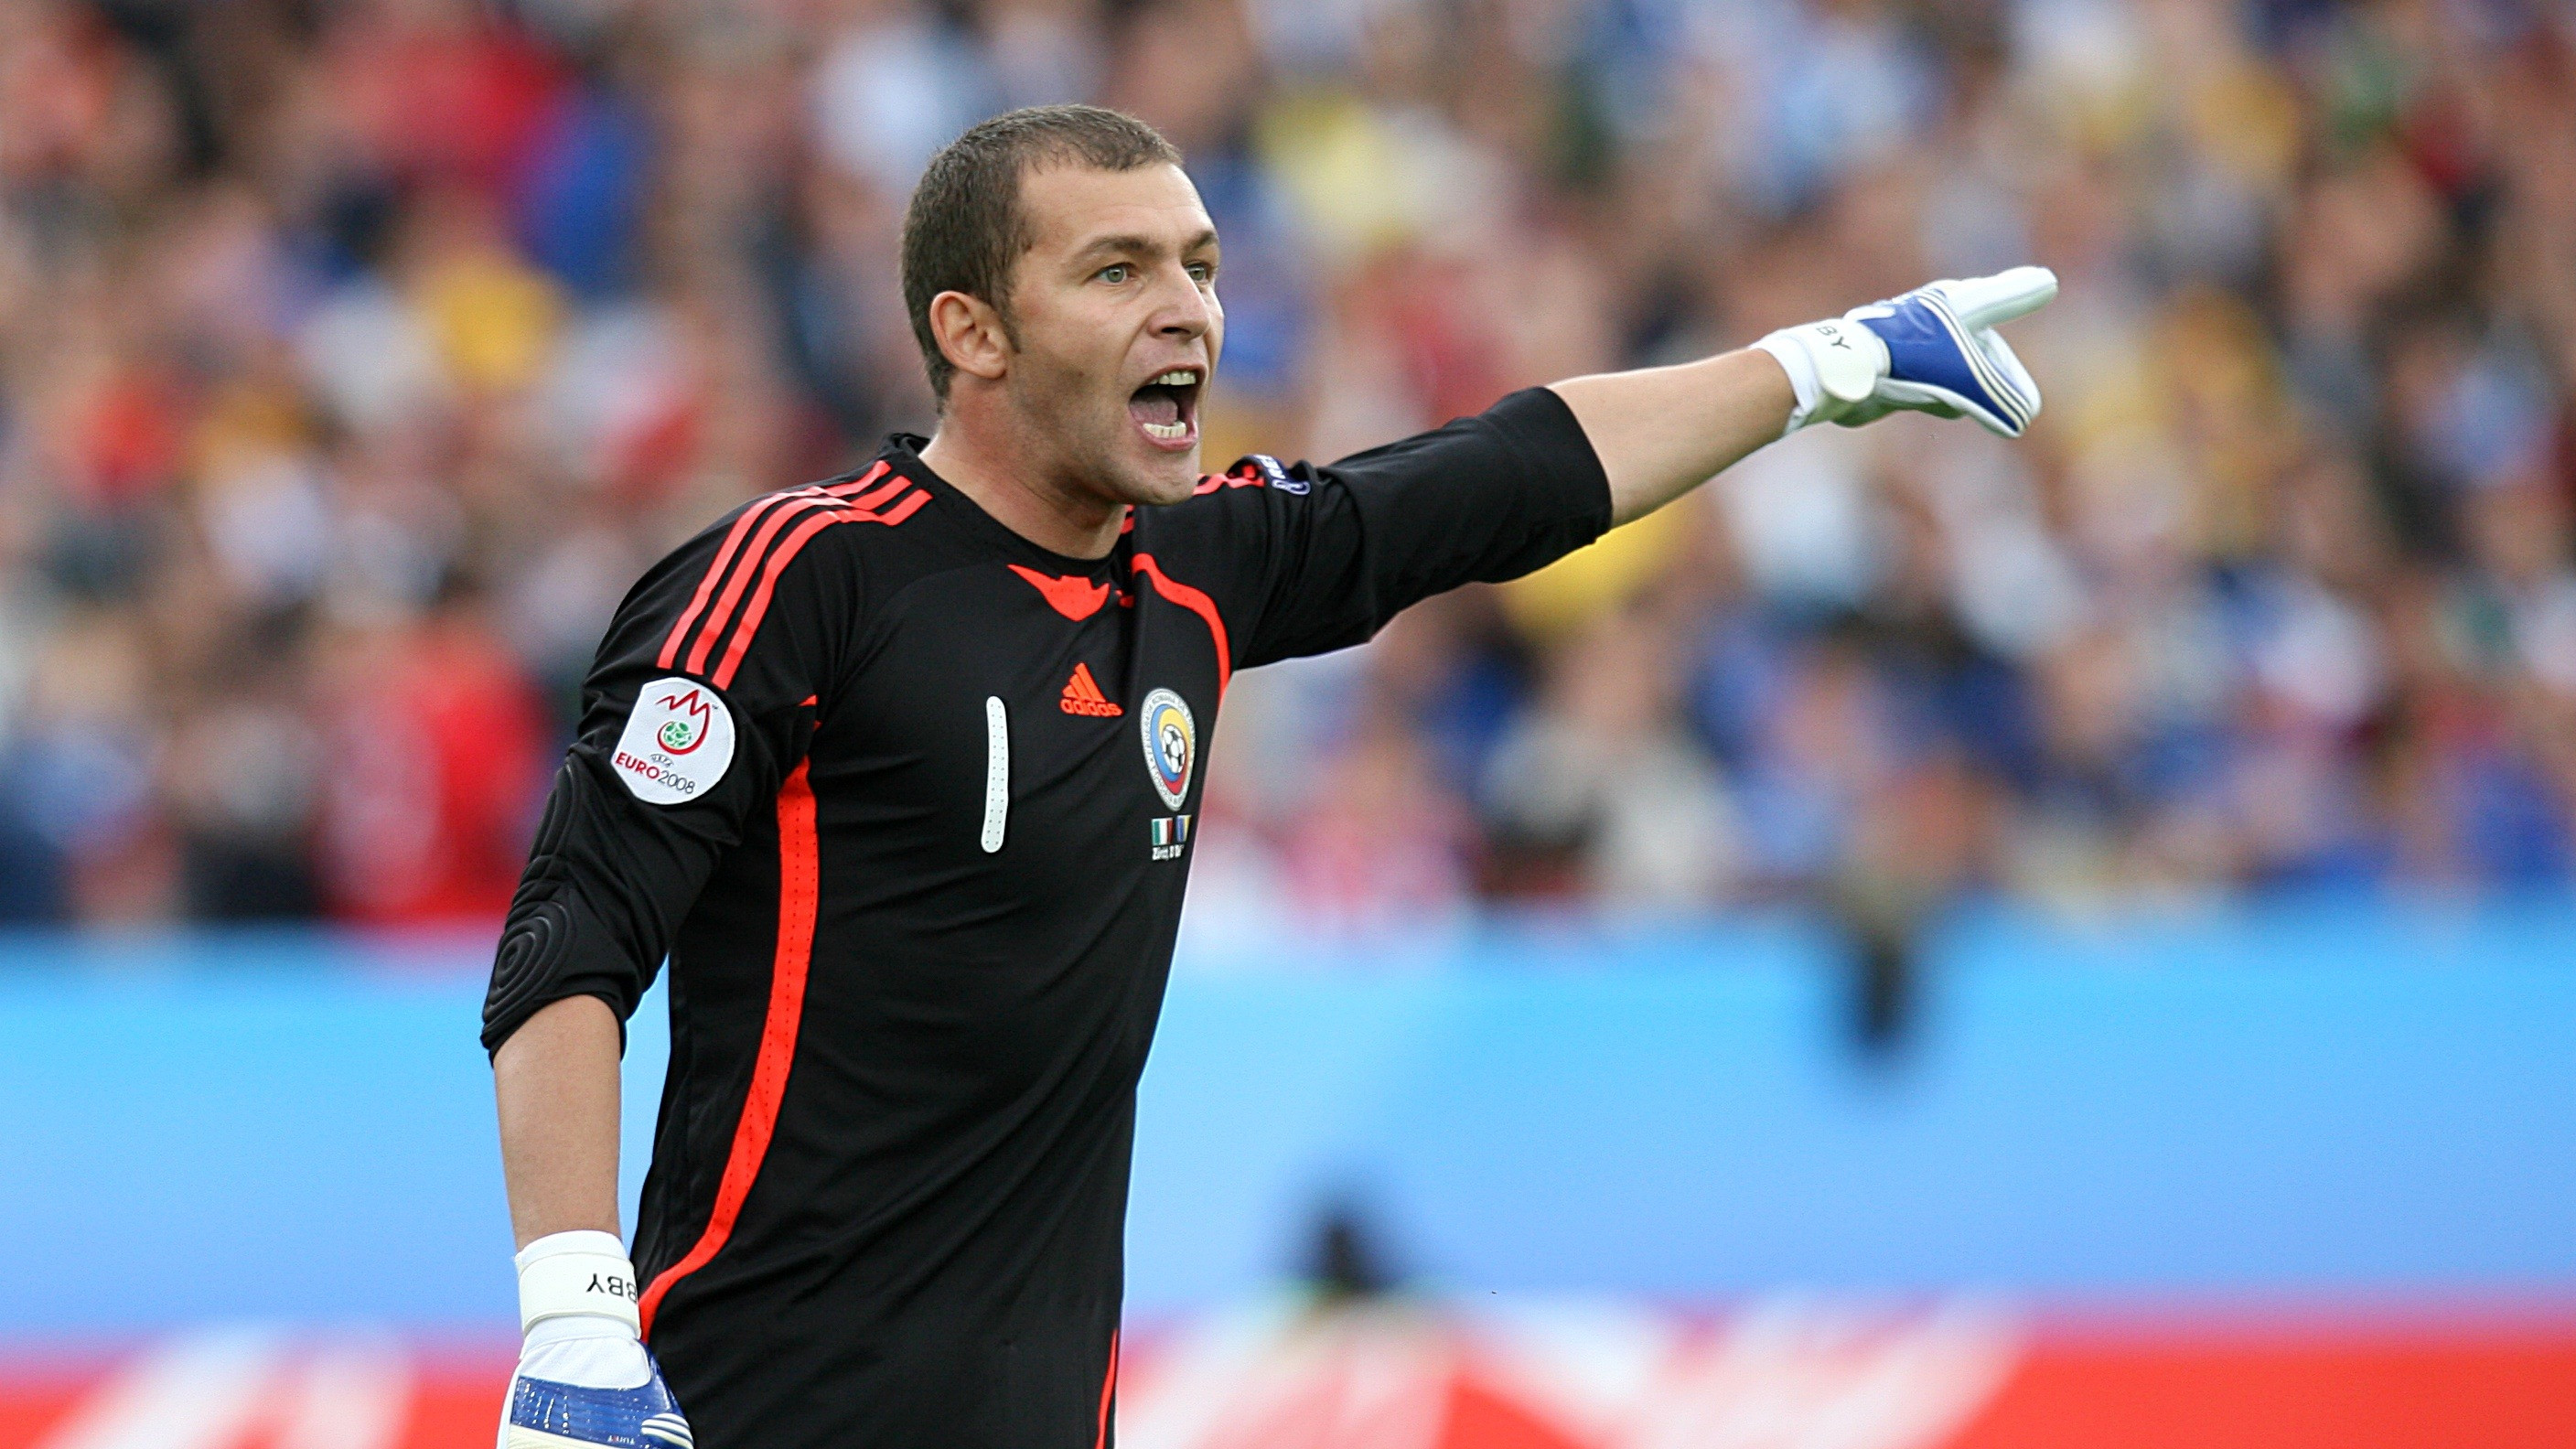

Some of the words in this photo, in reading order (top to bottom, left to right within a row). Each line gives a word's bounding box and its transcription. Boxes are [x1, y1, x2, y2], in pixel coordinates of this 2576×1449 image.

[1817, 326, 1852, 351] BY
[1060, 698, 1123, 718] adidas
[981, 695, 1009, 853] 1
